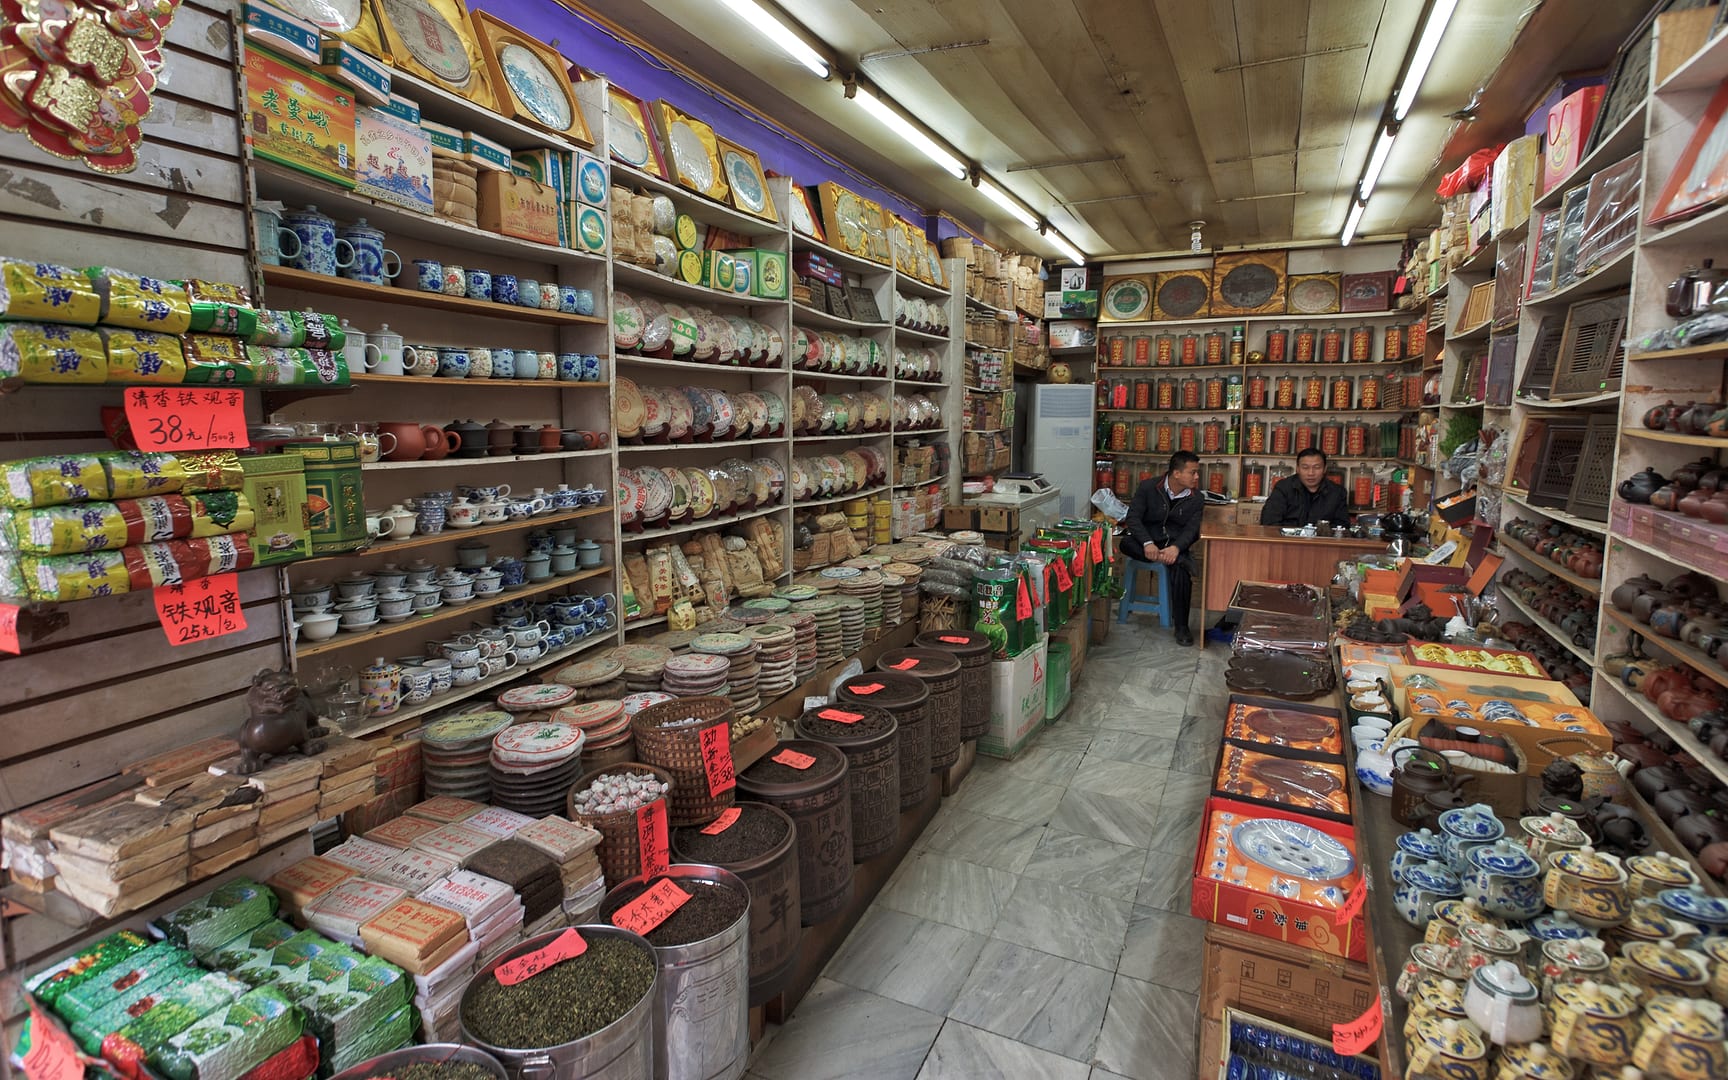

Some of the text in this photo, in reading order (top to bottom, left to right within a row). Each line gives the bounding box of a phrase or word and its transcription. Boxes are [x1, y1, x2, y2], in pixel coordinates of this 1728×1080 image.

[262, 88, 331, 137] 老曼峨
[132, 389, 241, 409] 清香铁观音
[163, 590, 238, 625] 铁观音
[180, 615, 236, 642] 25元/包
